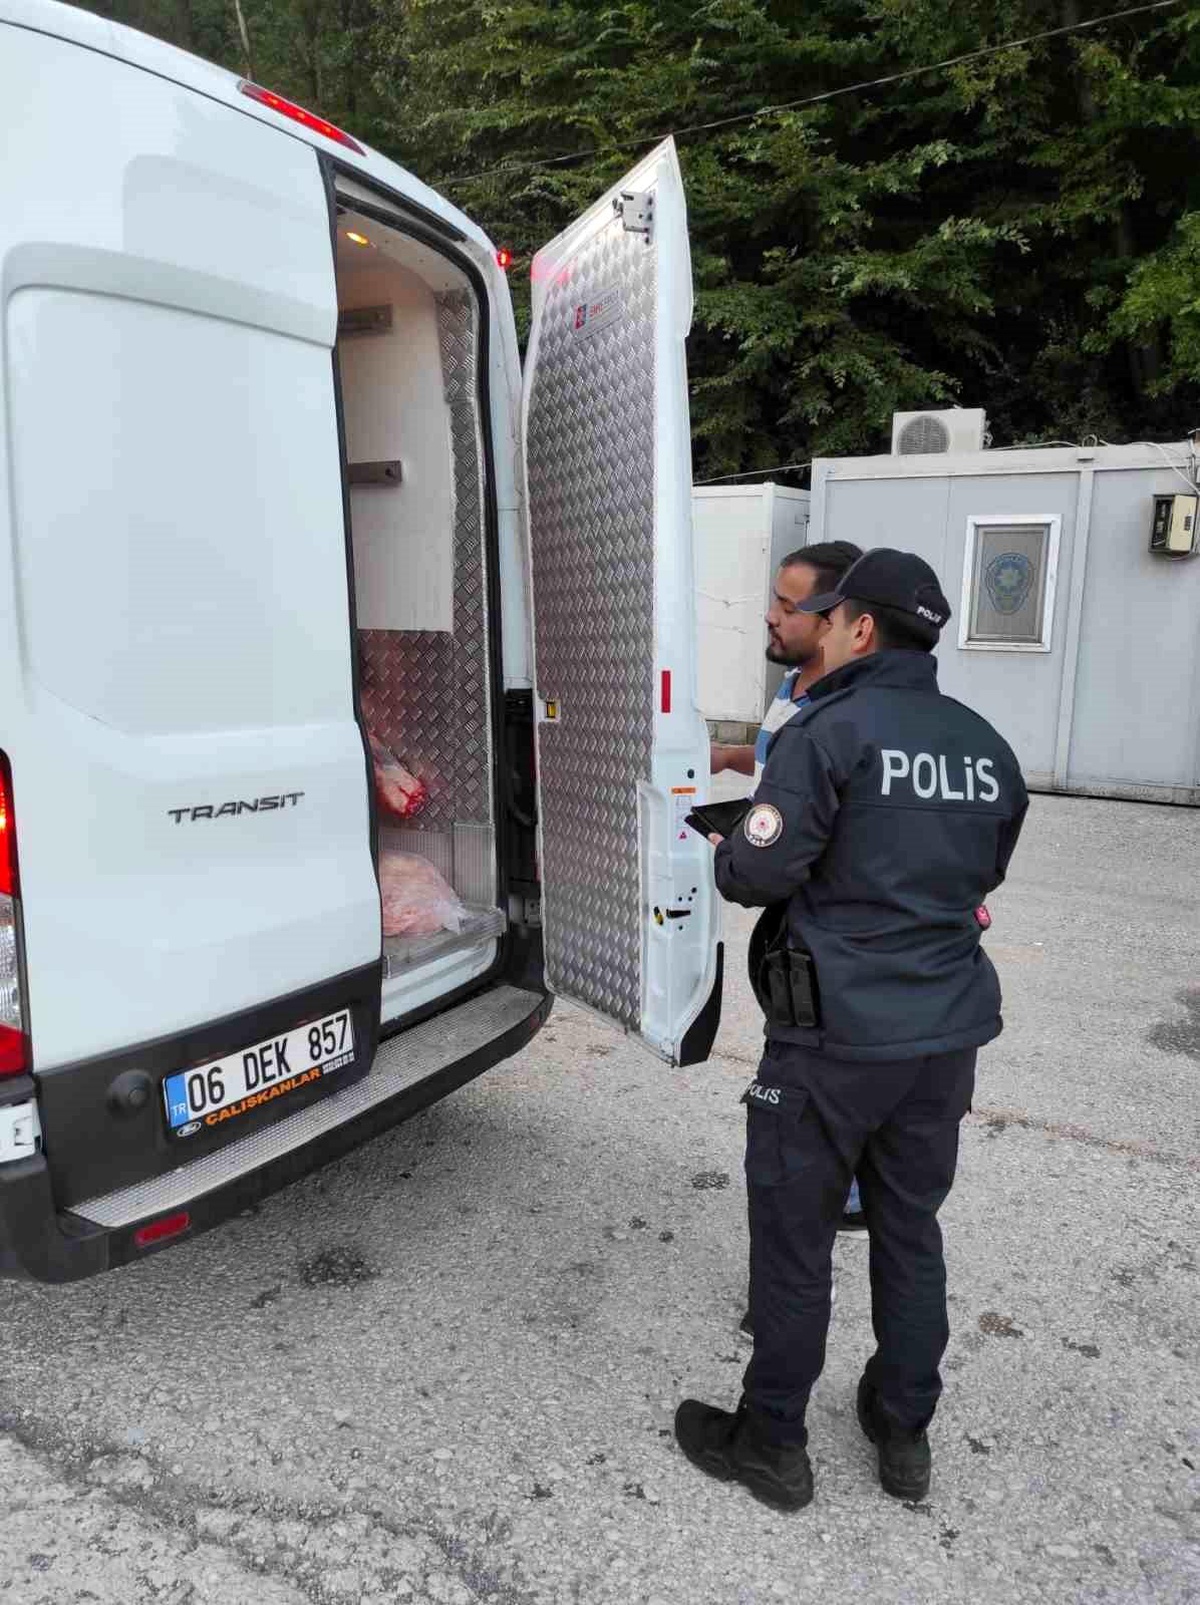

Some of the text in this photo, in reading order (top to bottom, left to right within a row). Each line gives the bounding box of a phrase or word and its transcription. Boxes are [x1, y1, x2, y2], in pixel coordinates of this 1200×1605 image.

[168, 791, 305, 824] TRANSIT
[187, 1066, 226, 1112] 06
[243, 1037, 291, 1091] DEK
[308, 1014, 348, 1061] 857
[747, 1083, 781, 1104] OLIS
[170, 1102, 186, 1117] TR
